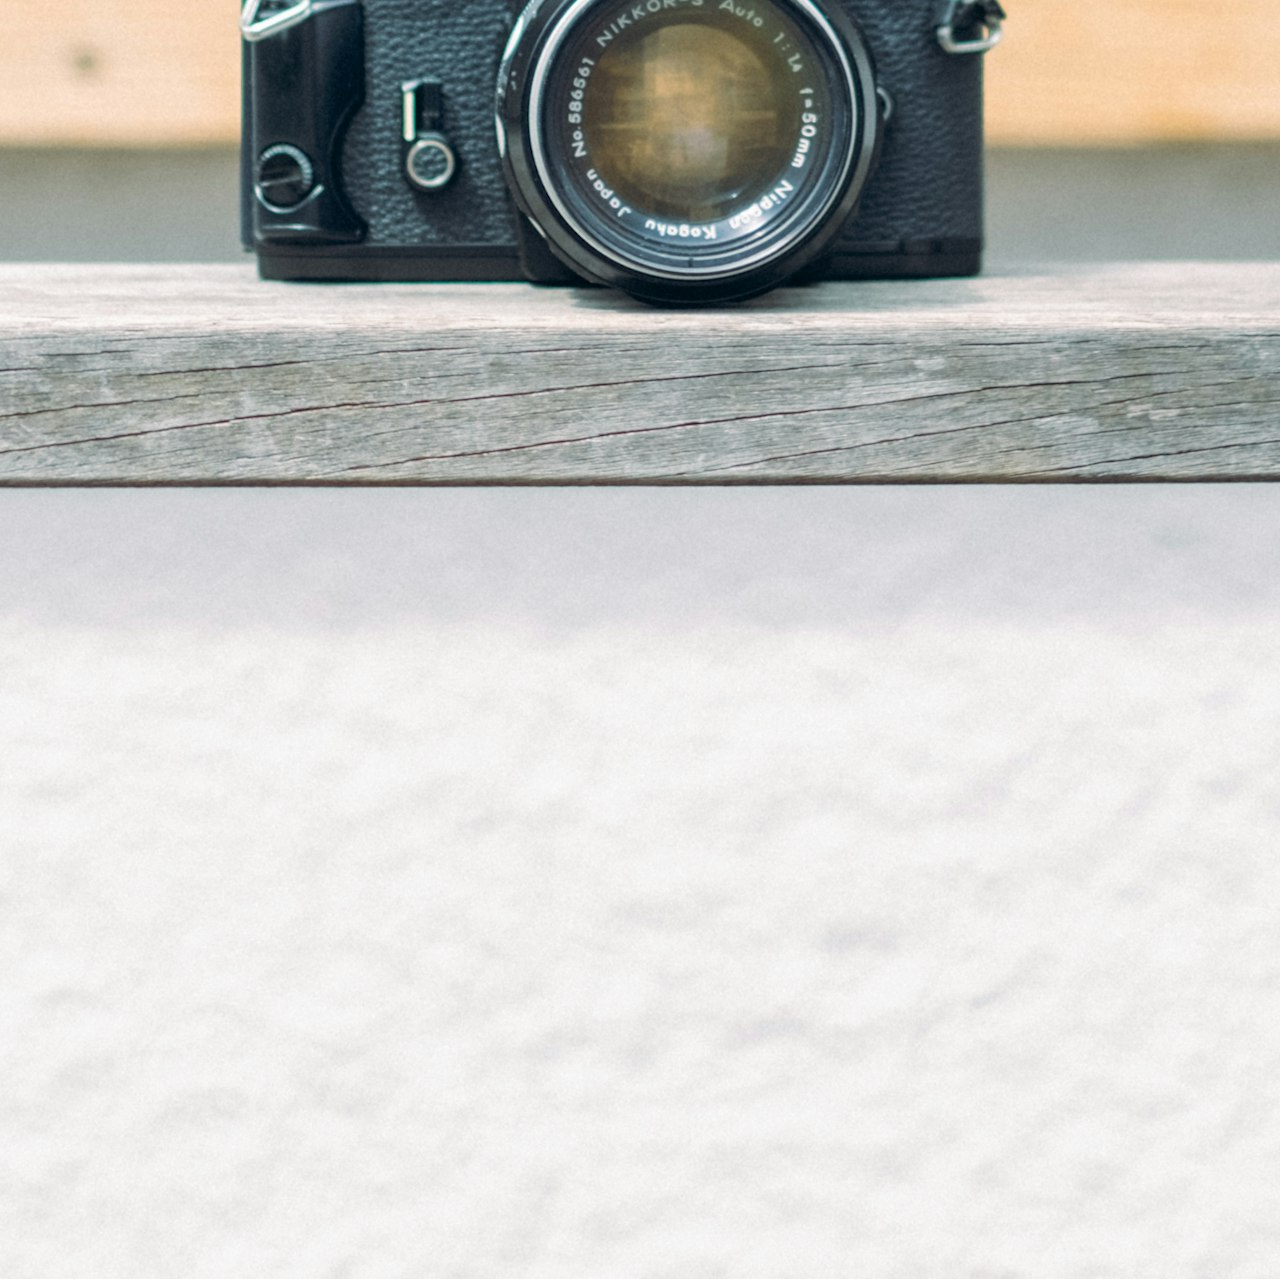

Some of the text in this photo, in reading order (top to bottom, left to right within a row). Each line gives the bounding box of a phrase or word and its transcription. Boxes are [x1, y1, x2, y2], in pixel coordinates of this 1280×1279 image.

[587, 169, 632, 217] Japan
[728, 180, 794, 230] Nippon
[645, 219, 717, 240] Kogaku
